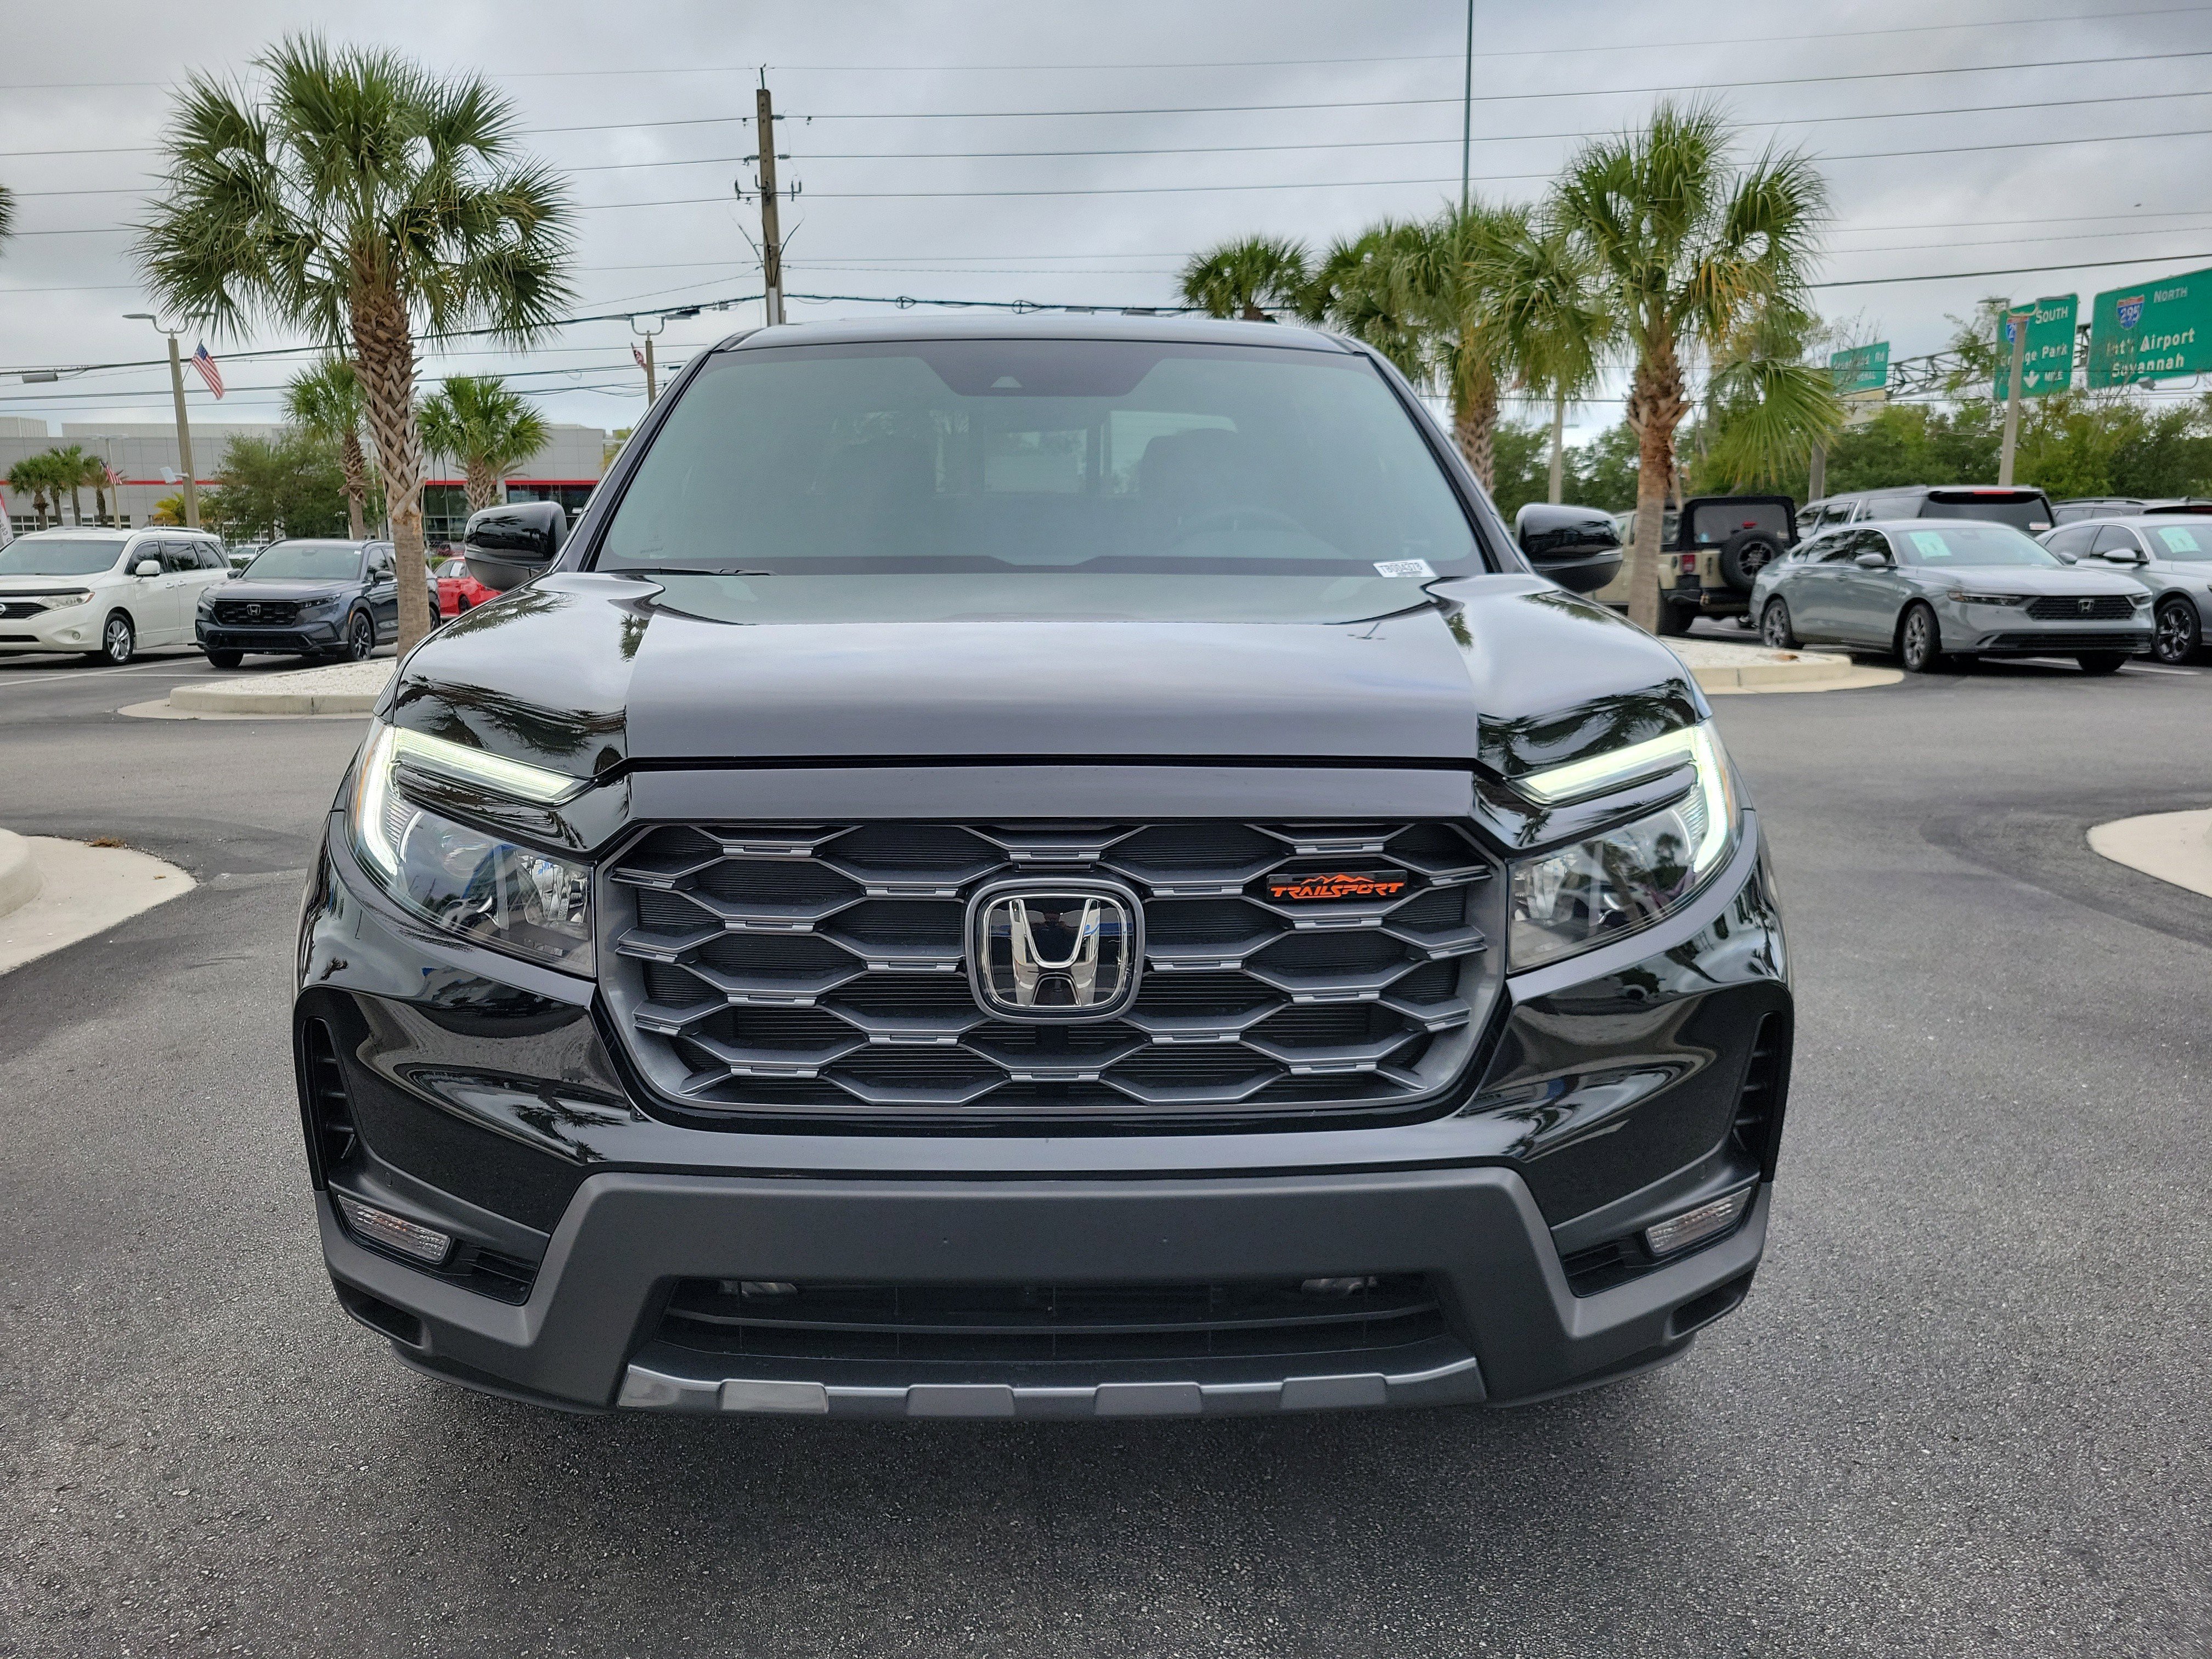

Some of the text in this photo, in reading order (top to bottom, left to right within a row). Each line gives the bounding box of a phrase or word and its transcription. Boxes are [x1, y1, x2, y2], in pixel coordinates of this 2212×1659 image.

[2154, 286, 2188, 303] NORTH
[2035, 306, 2068, 324] SOUTH
[2120, 305, 2140, 324] 295
[2140, 327, 2195, 352] Airport
[2042, 342, 2068, 359] Park
[2112, 352, 2185, 377] Savannah
[1270, 883, 1405, 899] TRAILSPORT
